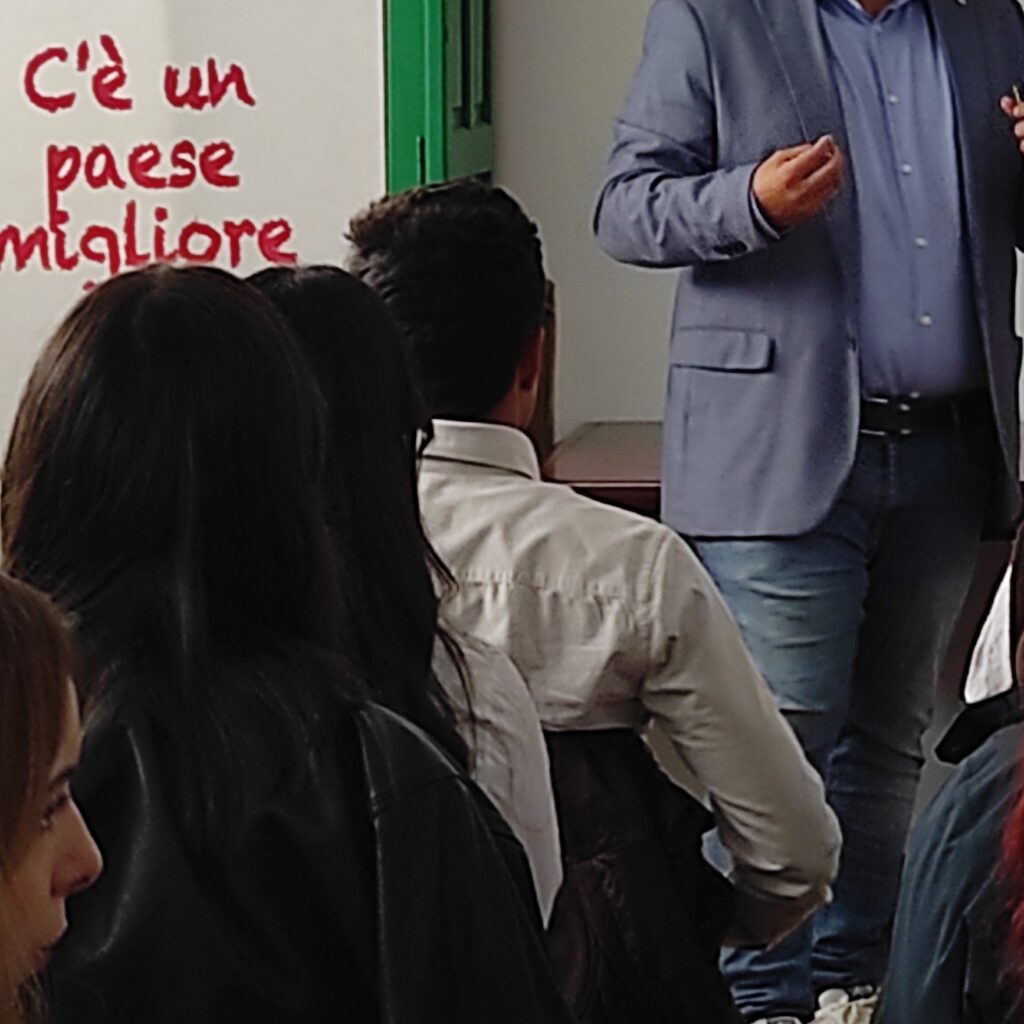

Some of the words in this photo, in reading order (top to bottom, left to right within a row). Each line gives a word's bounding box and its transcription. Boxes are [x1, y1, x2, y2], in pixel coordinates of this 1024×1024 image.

[24, 34, 132, 112] C'è
[164, 58, 256, 111] un
[47, 140, 240, 232] paese
[0, 200, 297, 291] migliore
